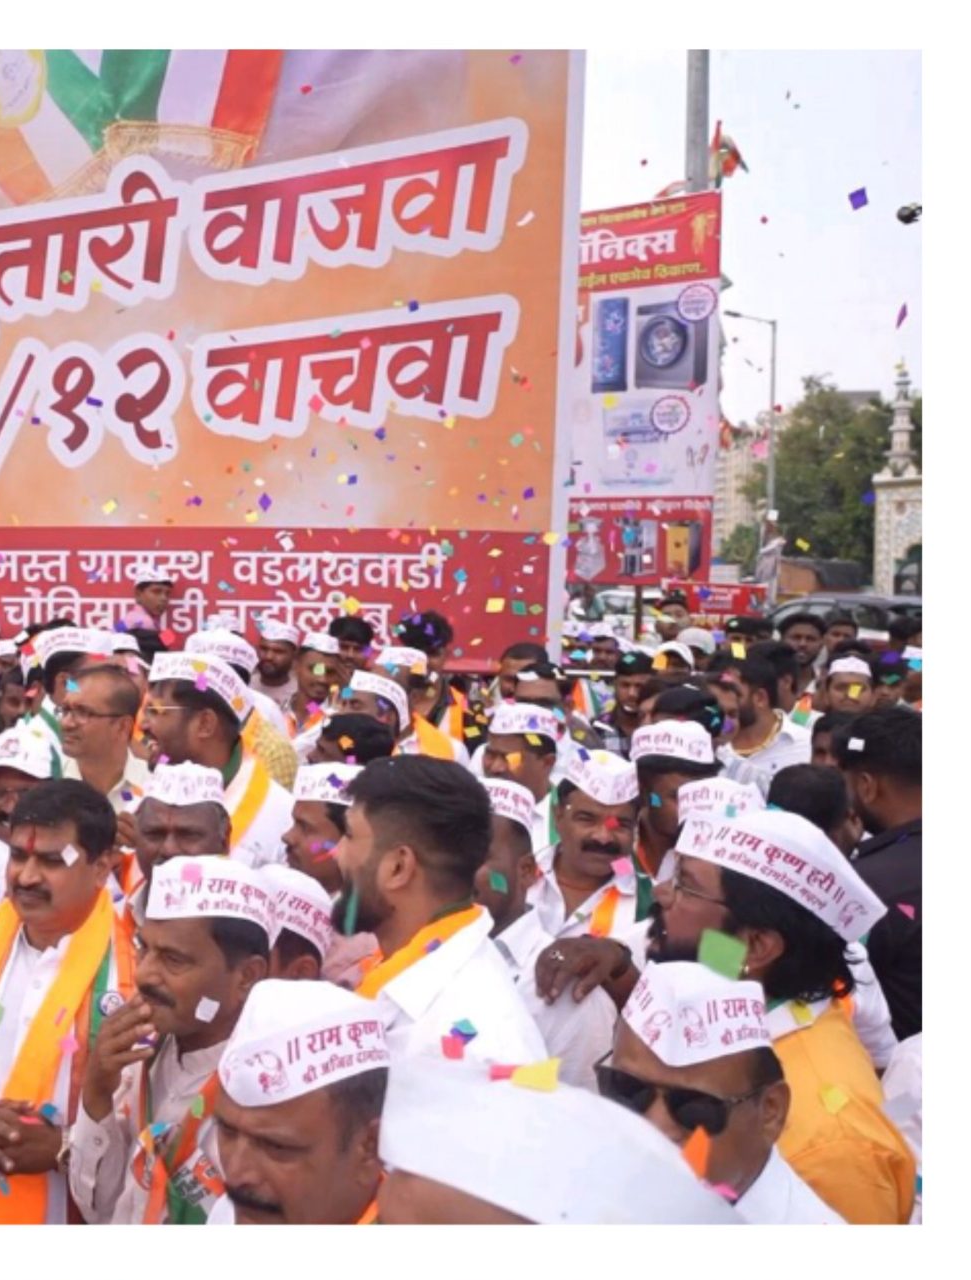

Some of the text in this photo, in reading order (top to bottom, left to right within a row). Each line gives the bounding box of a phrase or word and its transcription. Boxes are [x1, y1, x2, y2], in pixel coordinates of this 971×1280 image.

[202, 136, 510, 269] वाजवा
[578, 227, 678, 264] ॉनिक्स
[205, 311, 503, 427] वाचवा
[78, 549, 214, 585] ग्रामस्थ
[731, 829, 765, 853] राम
[764, 843, 810, 875] कृष्ण
[805, 868, 836, 895] हरी
[207, 877, 238, 896] राम
[720, 997, 750, 1019] राम
[306, 1024, 343, 1054] राम
[346, 1019, 381, 1049] कृष्ण
